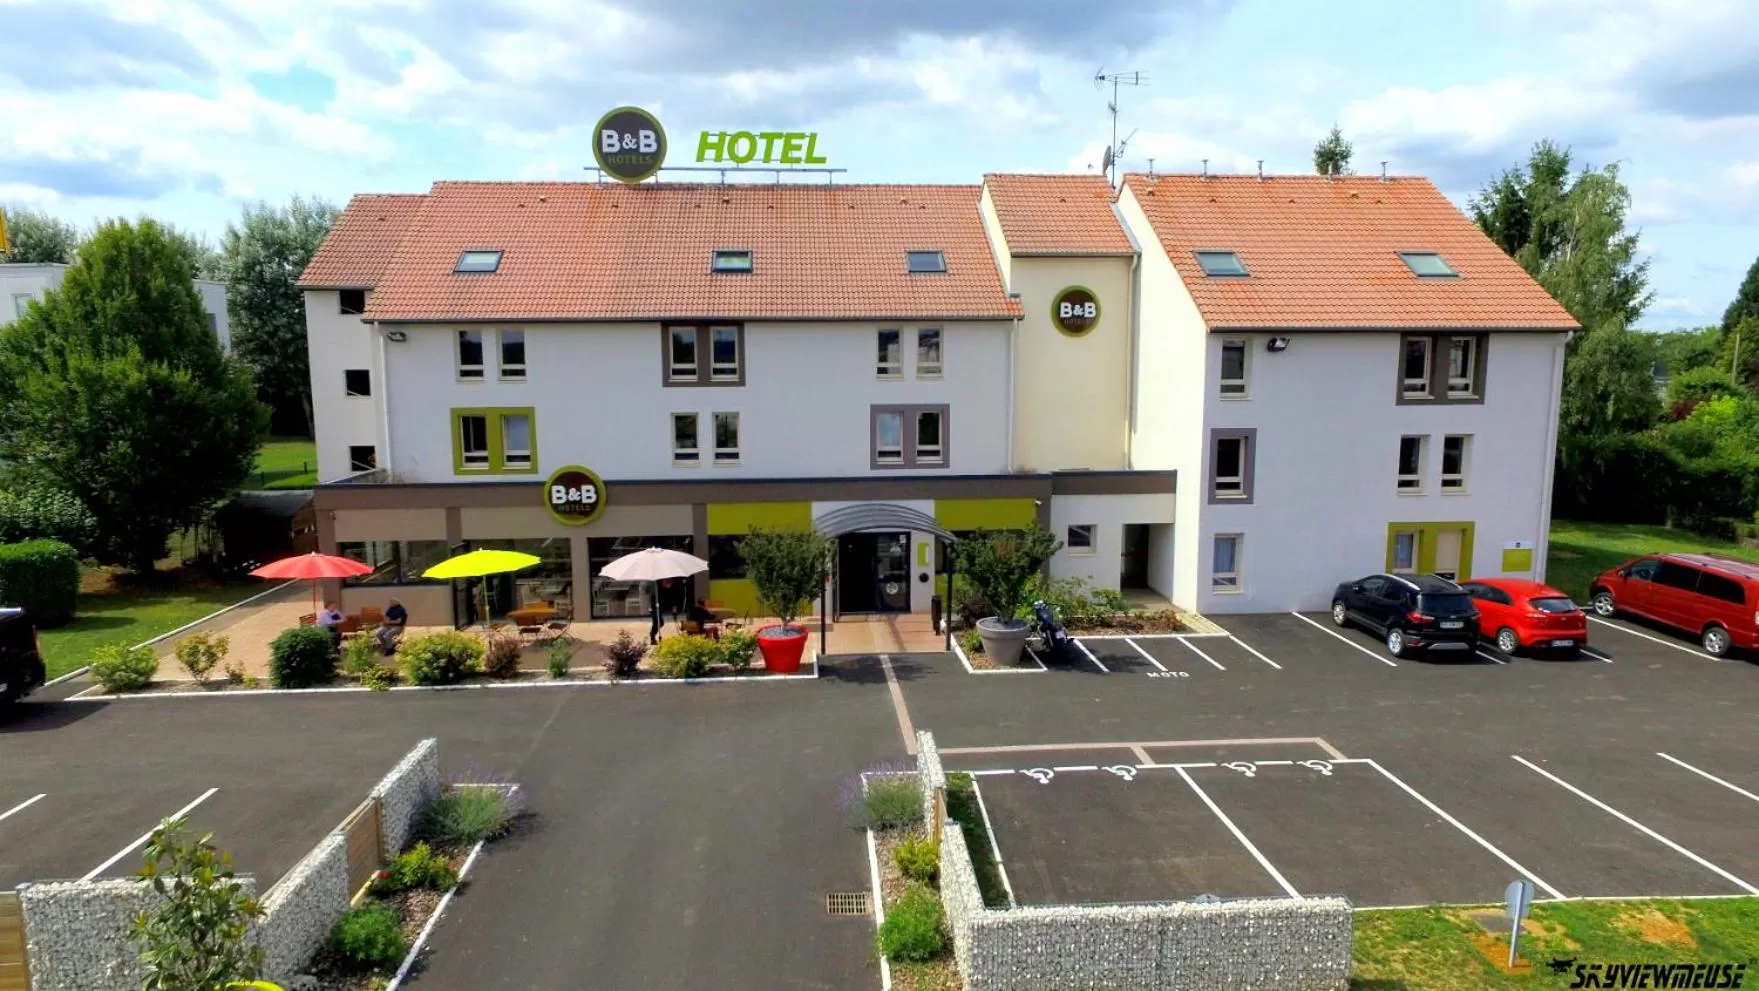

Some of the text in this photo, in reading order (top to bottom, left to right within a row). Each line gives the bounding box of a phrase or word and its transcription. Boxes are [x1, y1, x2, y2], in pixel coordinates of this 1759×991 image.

[601, 129, 657, 153] B&B
[696, 131, 827, 164] HOTEL
[608, 155, 652, 165] HOTELS
[1060, 302, 1096, 317] B&B
[551, 485, 597, 504] B&B
